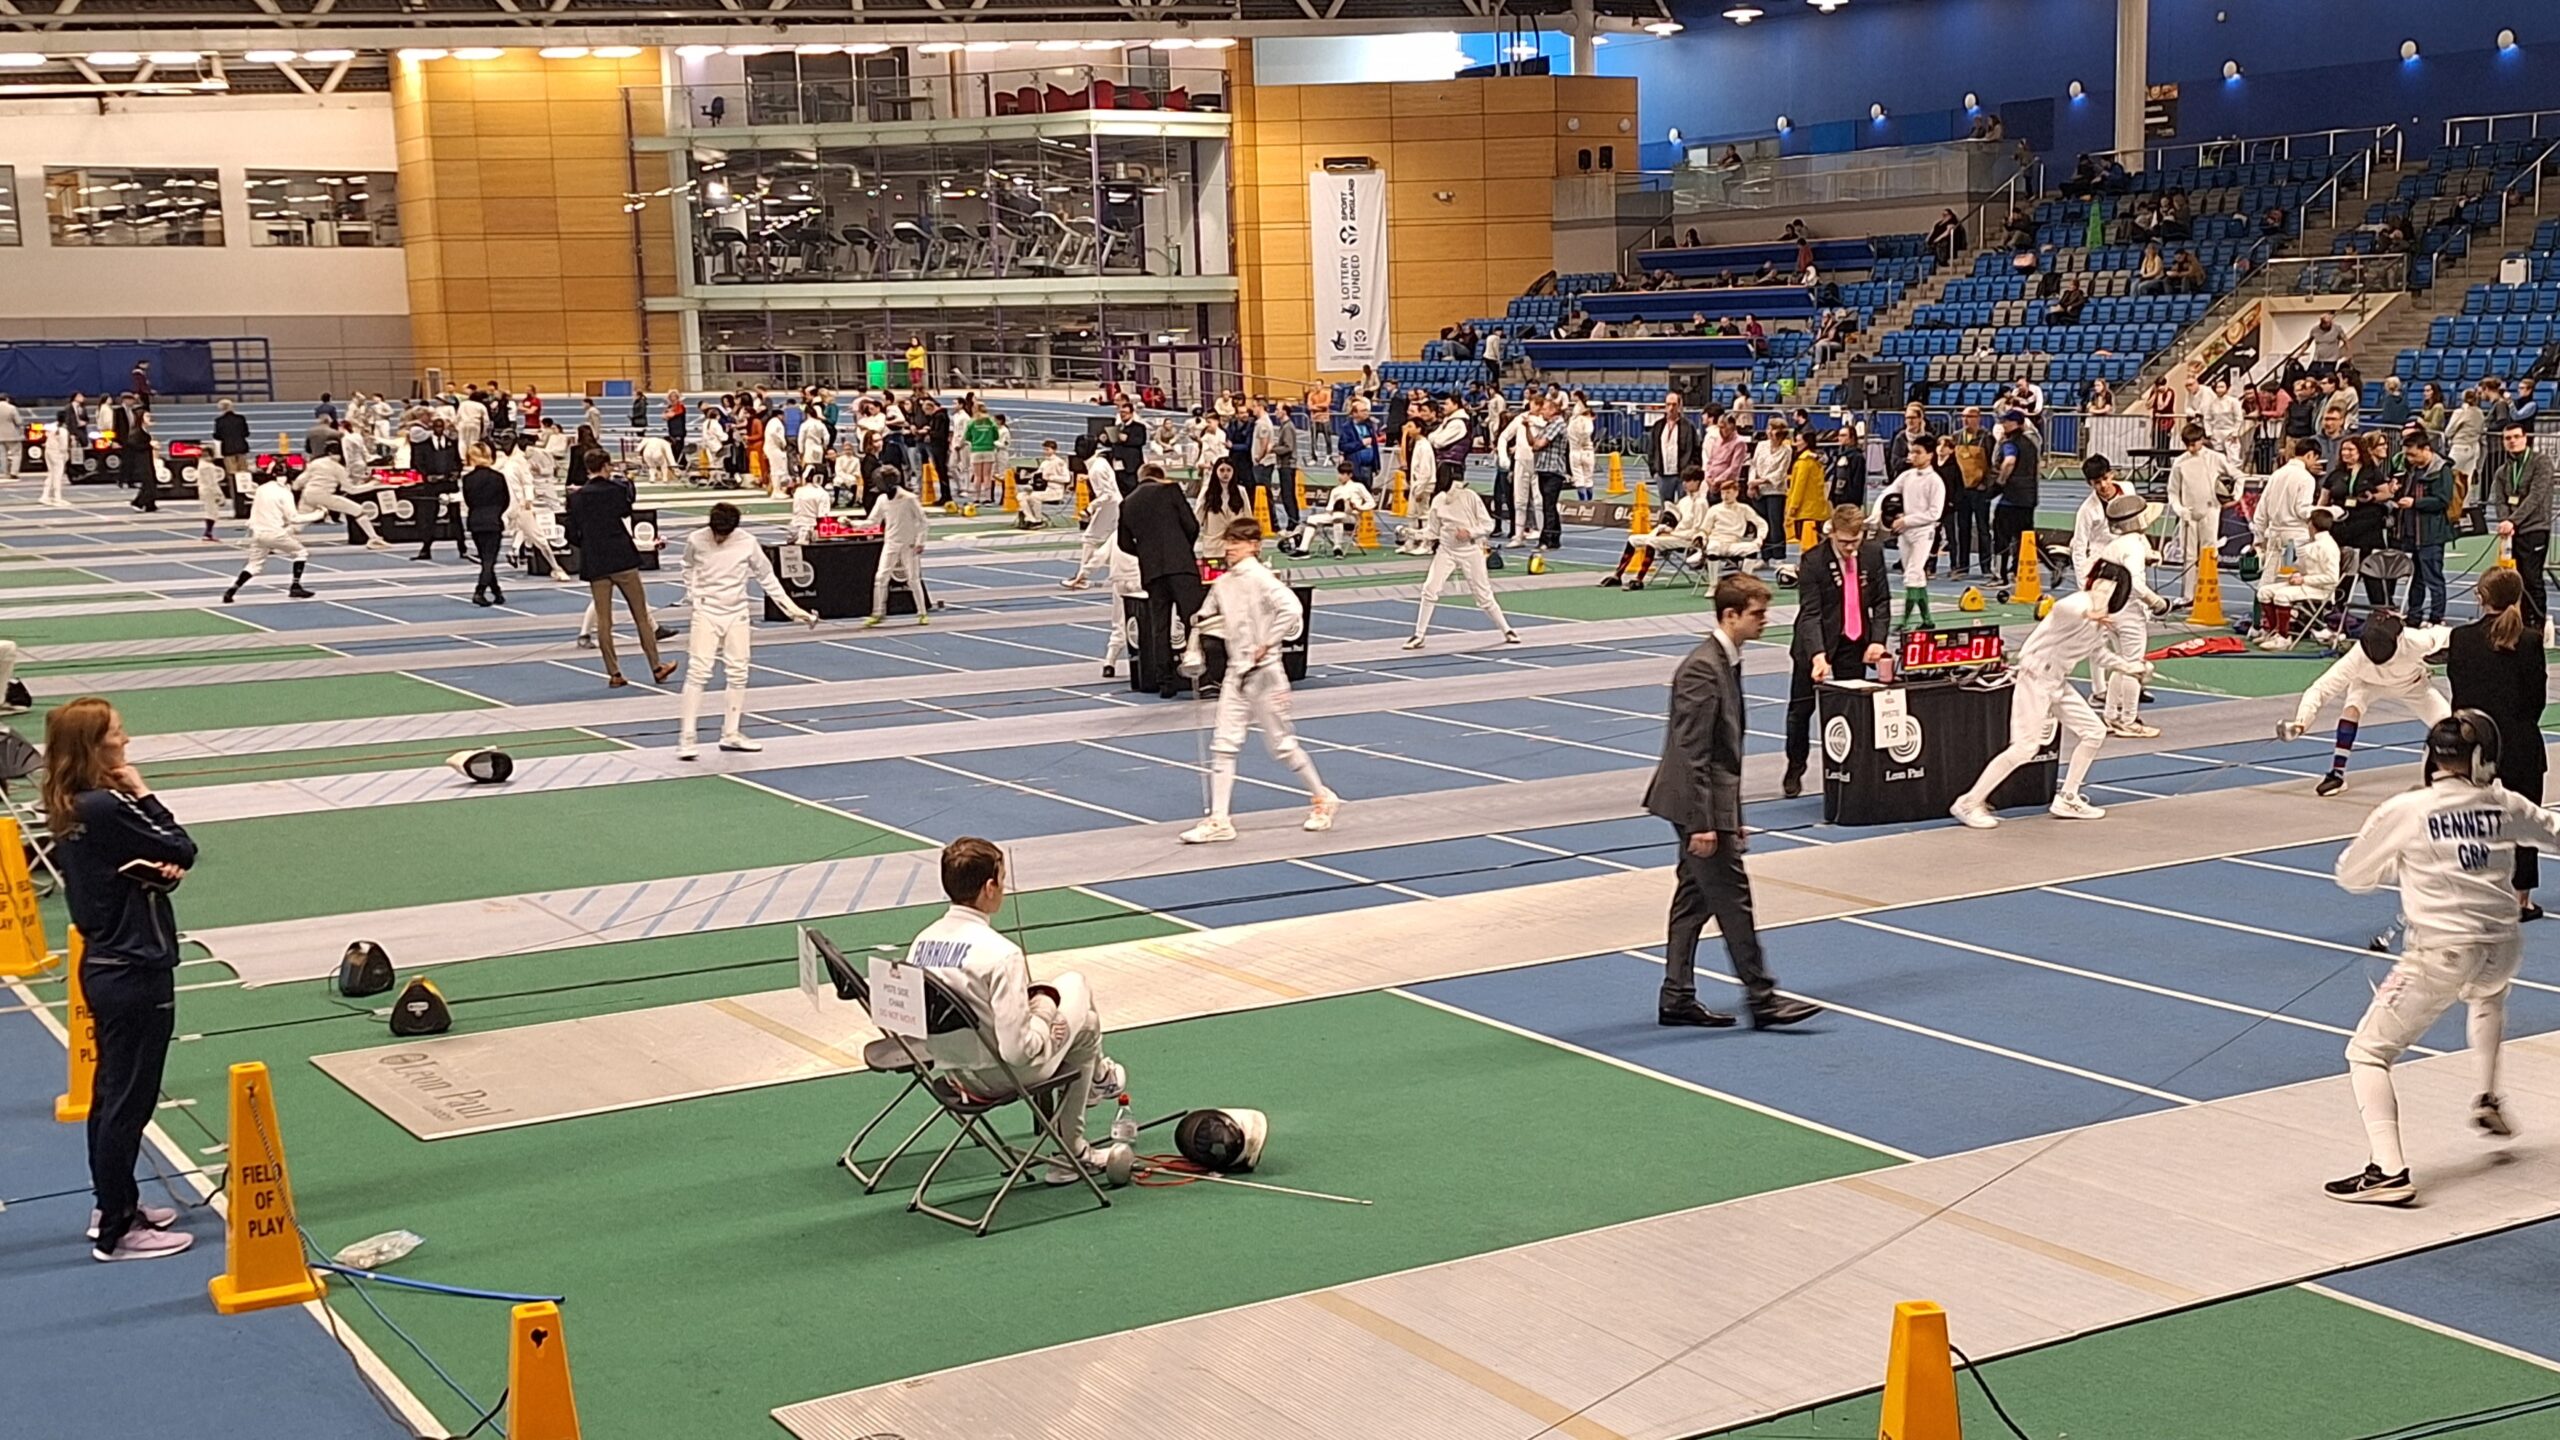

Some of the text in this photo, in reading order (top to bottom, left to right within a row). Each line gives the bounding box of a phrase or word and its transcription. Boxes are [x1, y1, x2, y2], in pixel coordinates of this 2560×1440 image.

[1340, 191, 1348, 221] SPORT
[1348, 178, 1356, 221] ENGLAND
[1340, 255, 1350, 300] LOTTERY
[1351, 254, 1361, 300] FUNDED
[1884, 723, 1899, 739] 19
[1907, 766, 1925, 780] Paul
[2427, 809, 2503, 841] BENNETT
[913, 939, 972, 970] FAIRHOLME
[80, 1047, 97, 1063] PL
[389, 1060, 515, 1119] Leon Paul
[242, 1163, 283, 1185] FIELD
[255, 1190, 275, 1211] OF
[248, 1216, 285, 1238] PLAY
